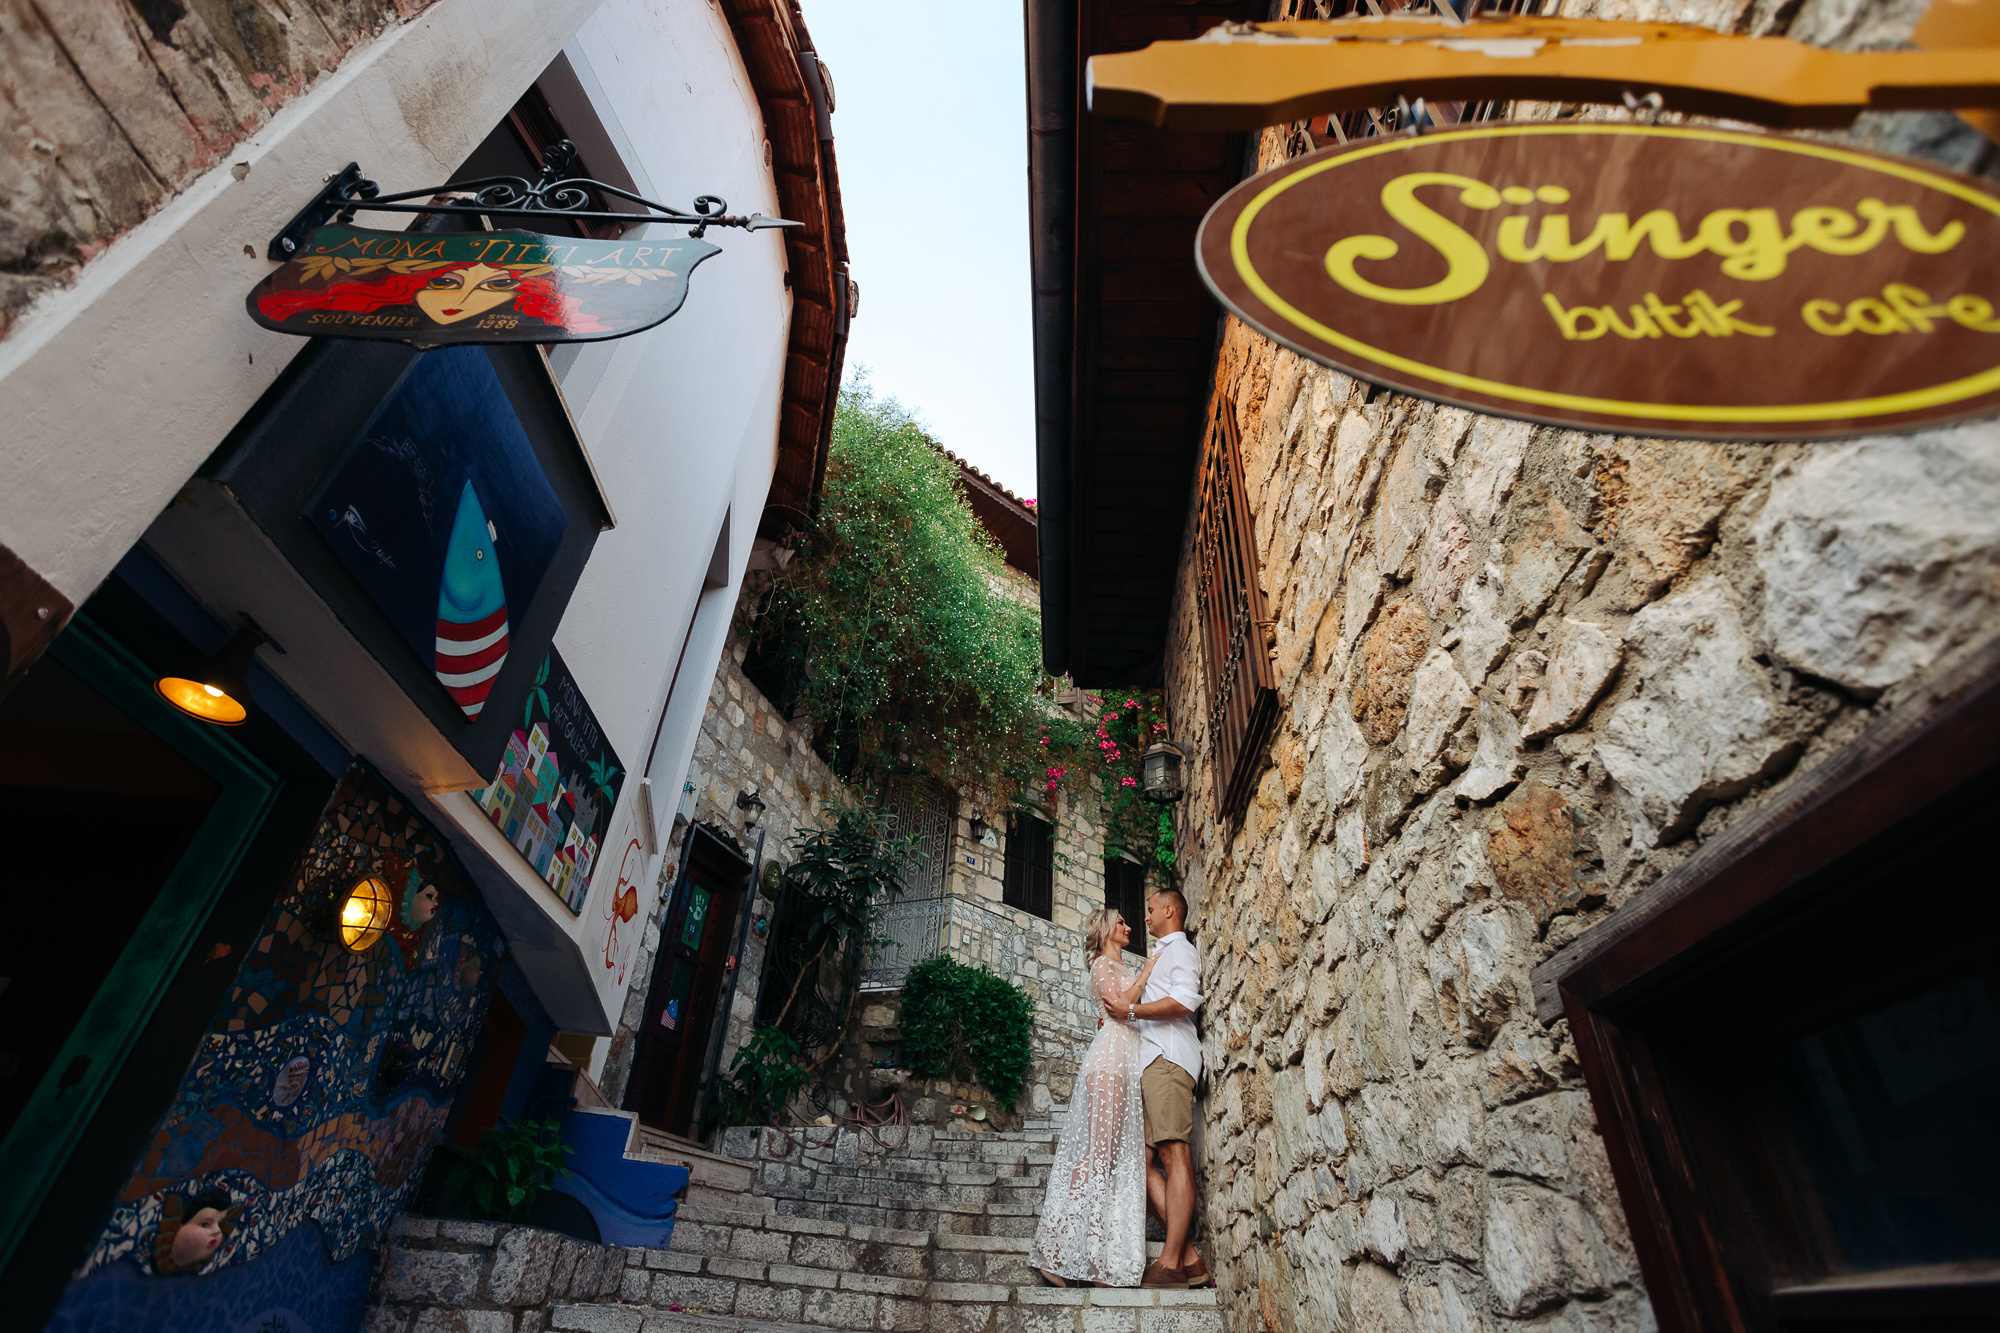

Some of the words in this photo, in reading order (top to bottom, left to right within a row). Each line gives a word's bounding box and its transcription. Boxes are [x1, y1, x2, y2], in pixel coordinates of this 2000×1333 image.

[315, 236, 447, 259] MONA
[469, 239, 580, 263] TITTI
[585, 246, 682, 267] ART
[1324, 171, 1965, 305] Sünger
[475, 319, 519, 330] 1988
[1542, 288, 1776, 342] butik
[1801, 282, 2000, 335] cafe
[558, 675, 583, 723] MONA
[551, 701, 569, 730] ART
[564, 721, 590, 763] GALLERY
